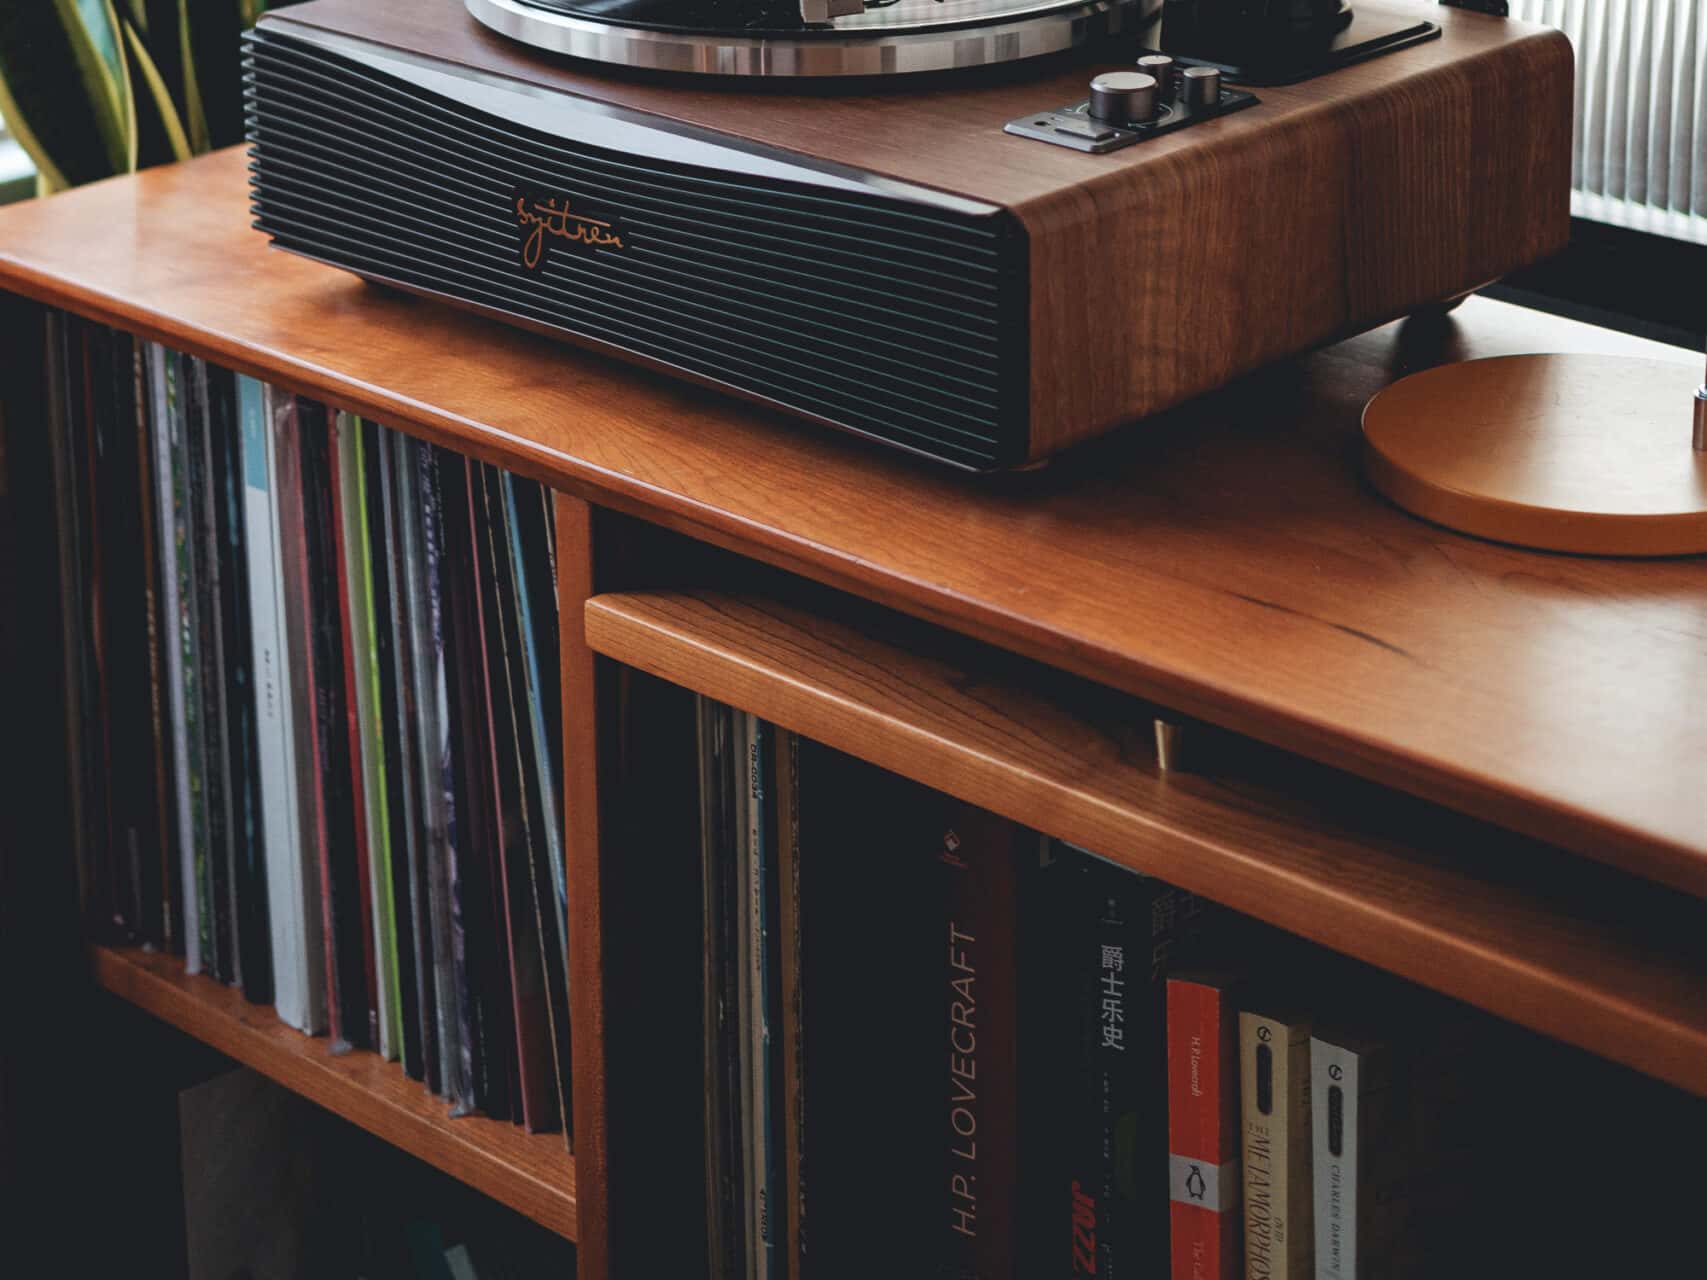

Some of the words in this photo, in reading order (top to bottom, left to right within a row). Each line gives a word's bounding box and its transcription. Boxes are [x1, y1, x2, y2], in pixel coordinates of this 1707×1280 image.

[1100, 944, 1125, 1050] 爵士乐史
[951, 920, 977, 1162] LOVECRAFT
[1191, 1055, 1203, 1097] Lovecraft
[951, 1174, 977, 1237] H.P.
[1330, 1164, 1341, 1219] CHARLES
[1072, 1179, 1096, 1275] JAZZ
[1330, 1222, 1341, 1272] DARWIN
